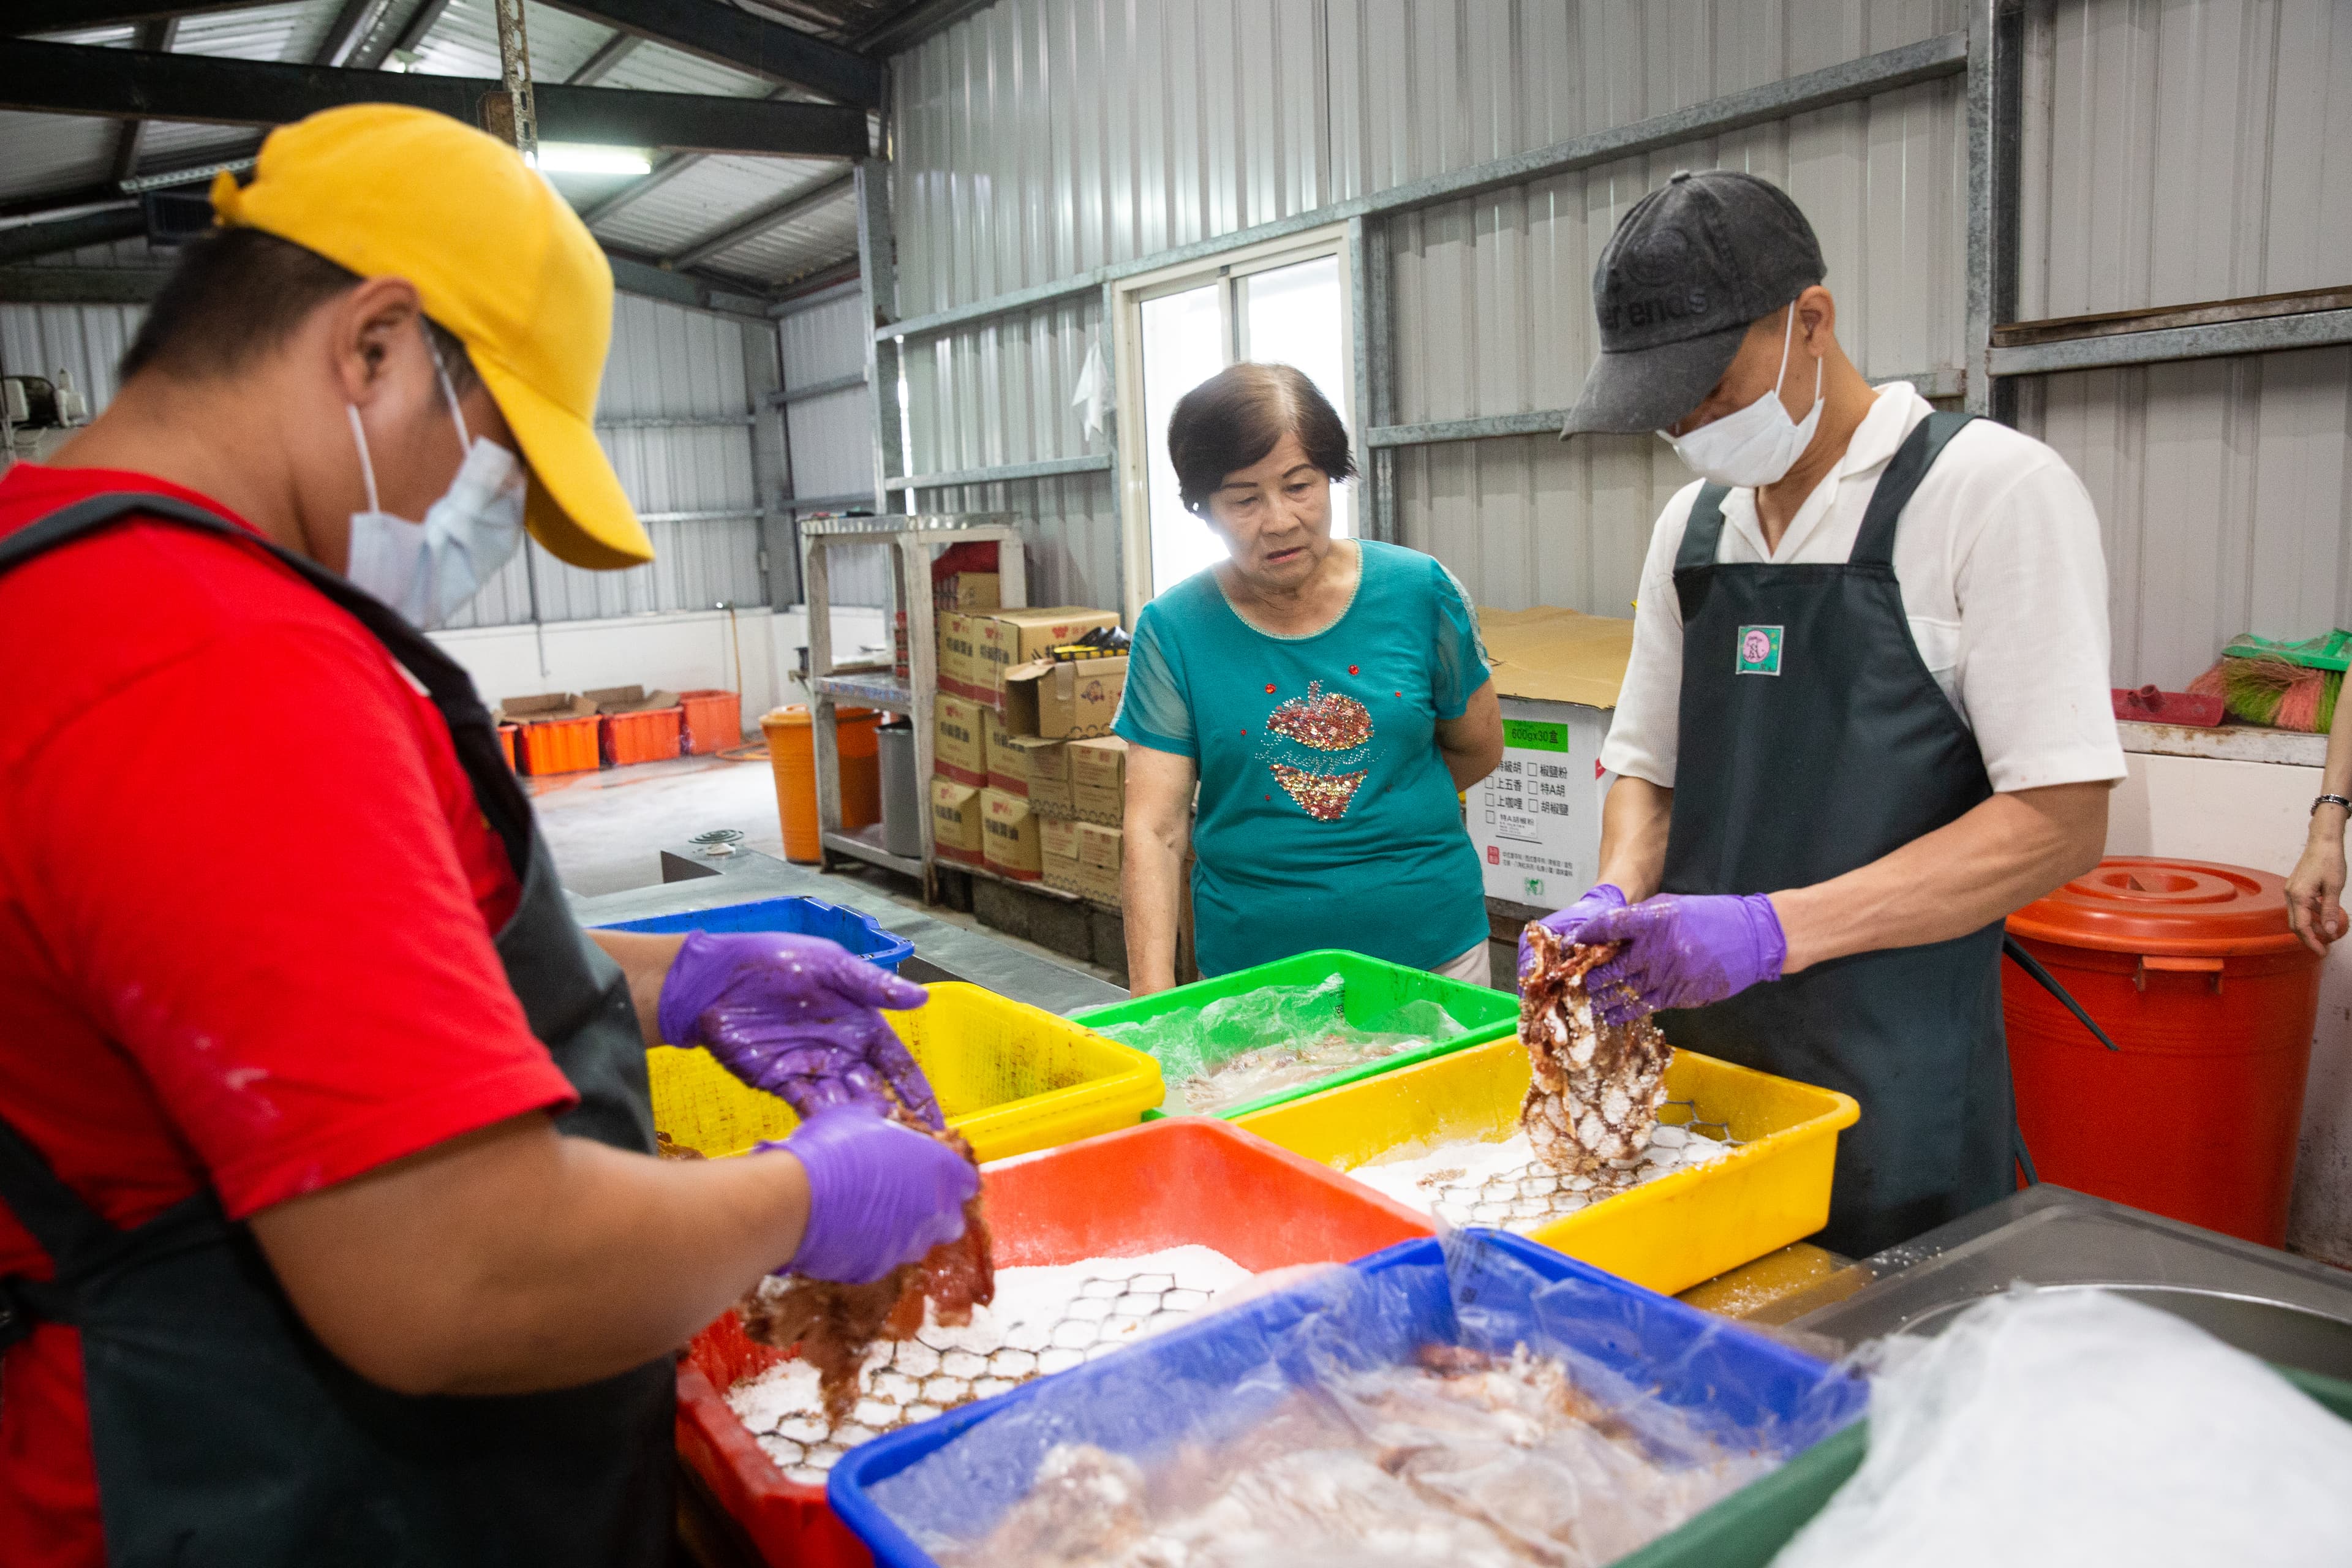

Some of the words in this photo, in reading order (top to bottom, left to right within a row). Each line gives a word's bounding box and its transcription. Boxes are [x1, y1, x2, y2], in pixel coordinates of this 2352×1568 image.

[1512, 728, 1558, 744] 600gx30盒
[1540, 764, 1567, 778] 椒鹽粉
[1496, 777, 1522, 791] 上五香
[1540, 783, 1565, 797] 特A胡
[1497, 796, 1523, 810] 上咖哩
[1541, 801, 1569, 816] 胡椒鹽
